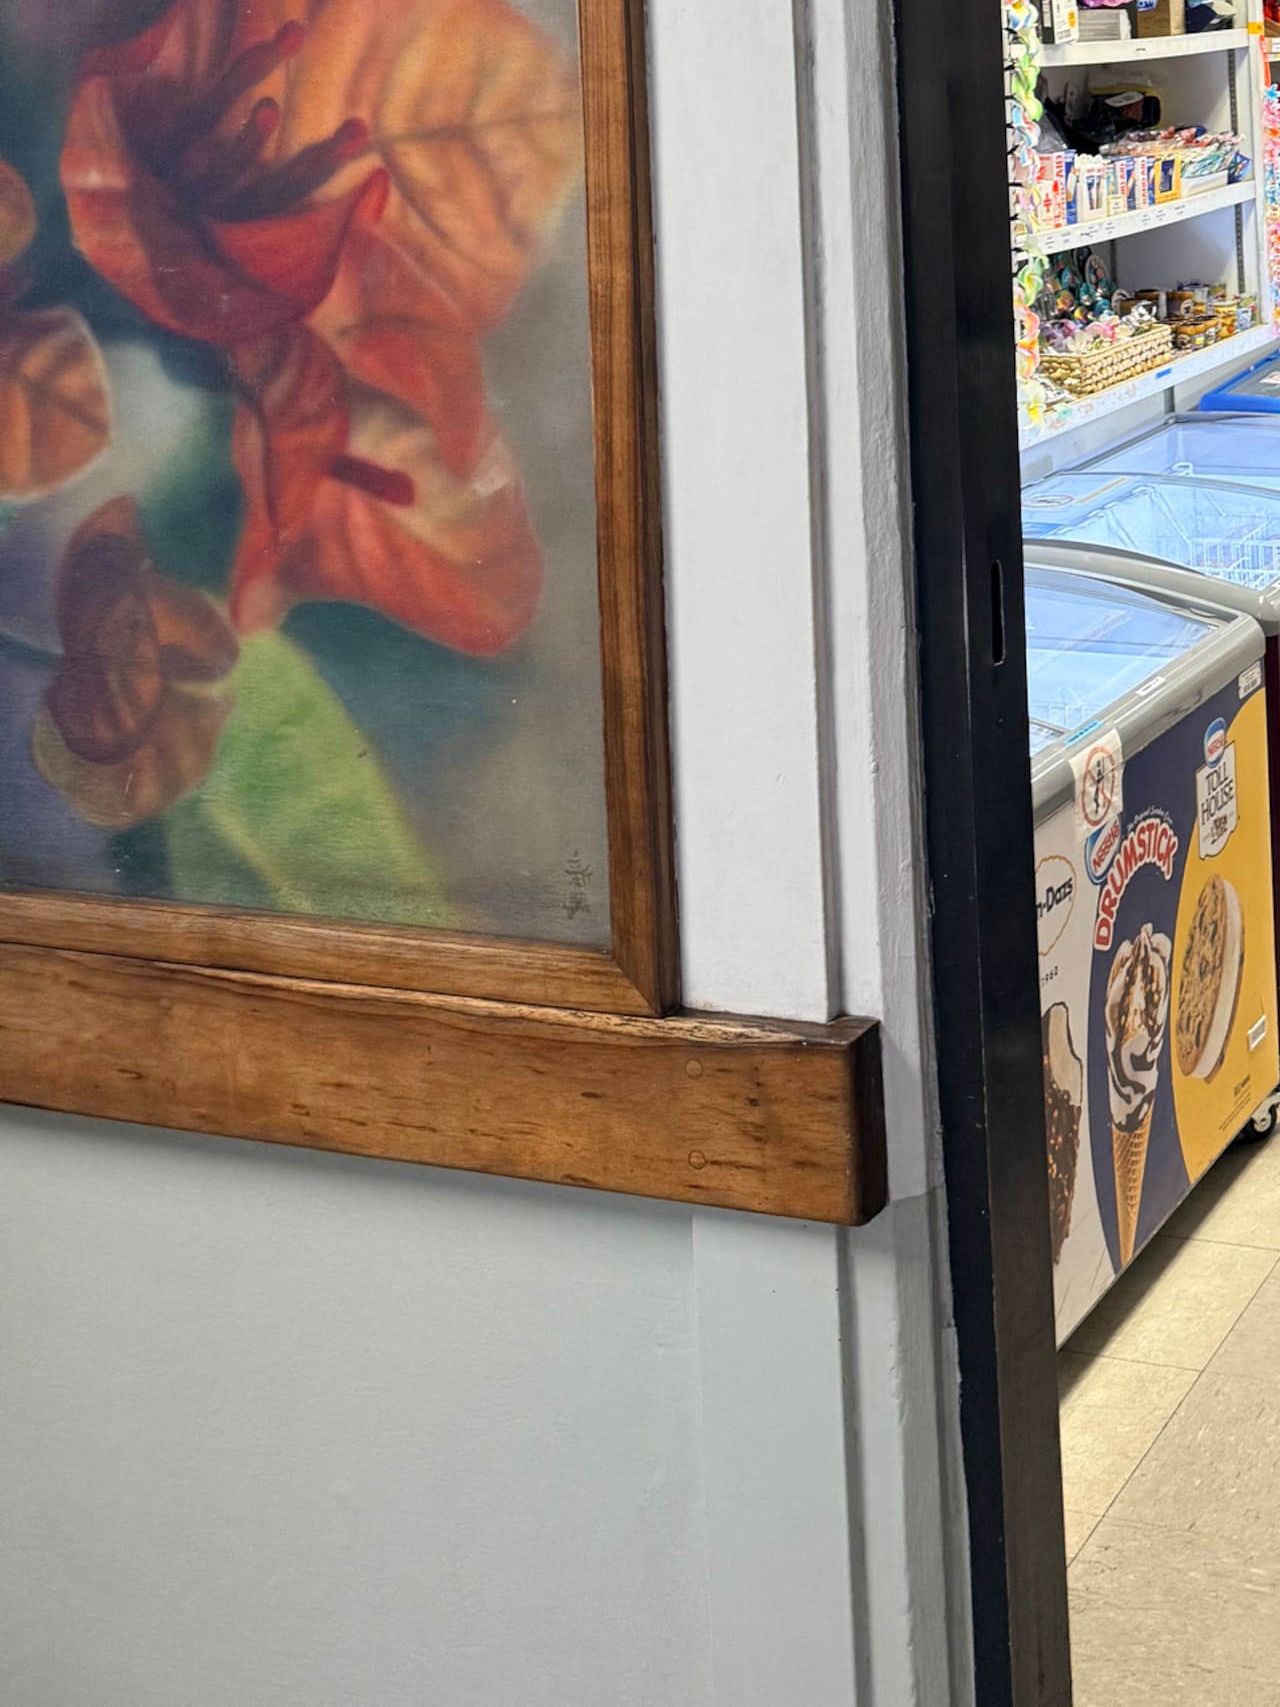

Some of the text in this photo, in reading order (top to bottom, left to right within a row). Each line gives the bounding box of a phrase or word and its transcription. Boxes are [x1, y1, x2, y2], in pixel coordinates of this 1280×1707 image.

[1201, 779, 1234, 825] HOUSE
[1205, 762, 1228, 796] TOLL
[1095, 819, 1178, 950] DRUMSTICK
